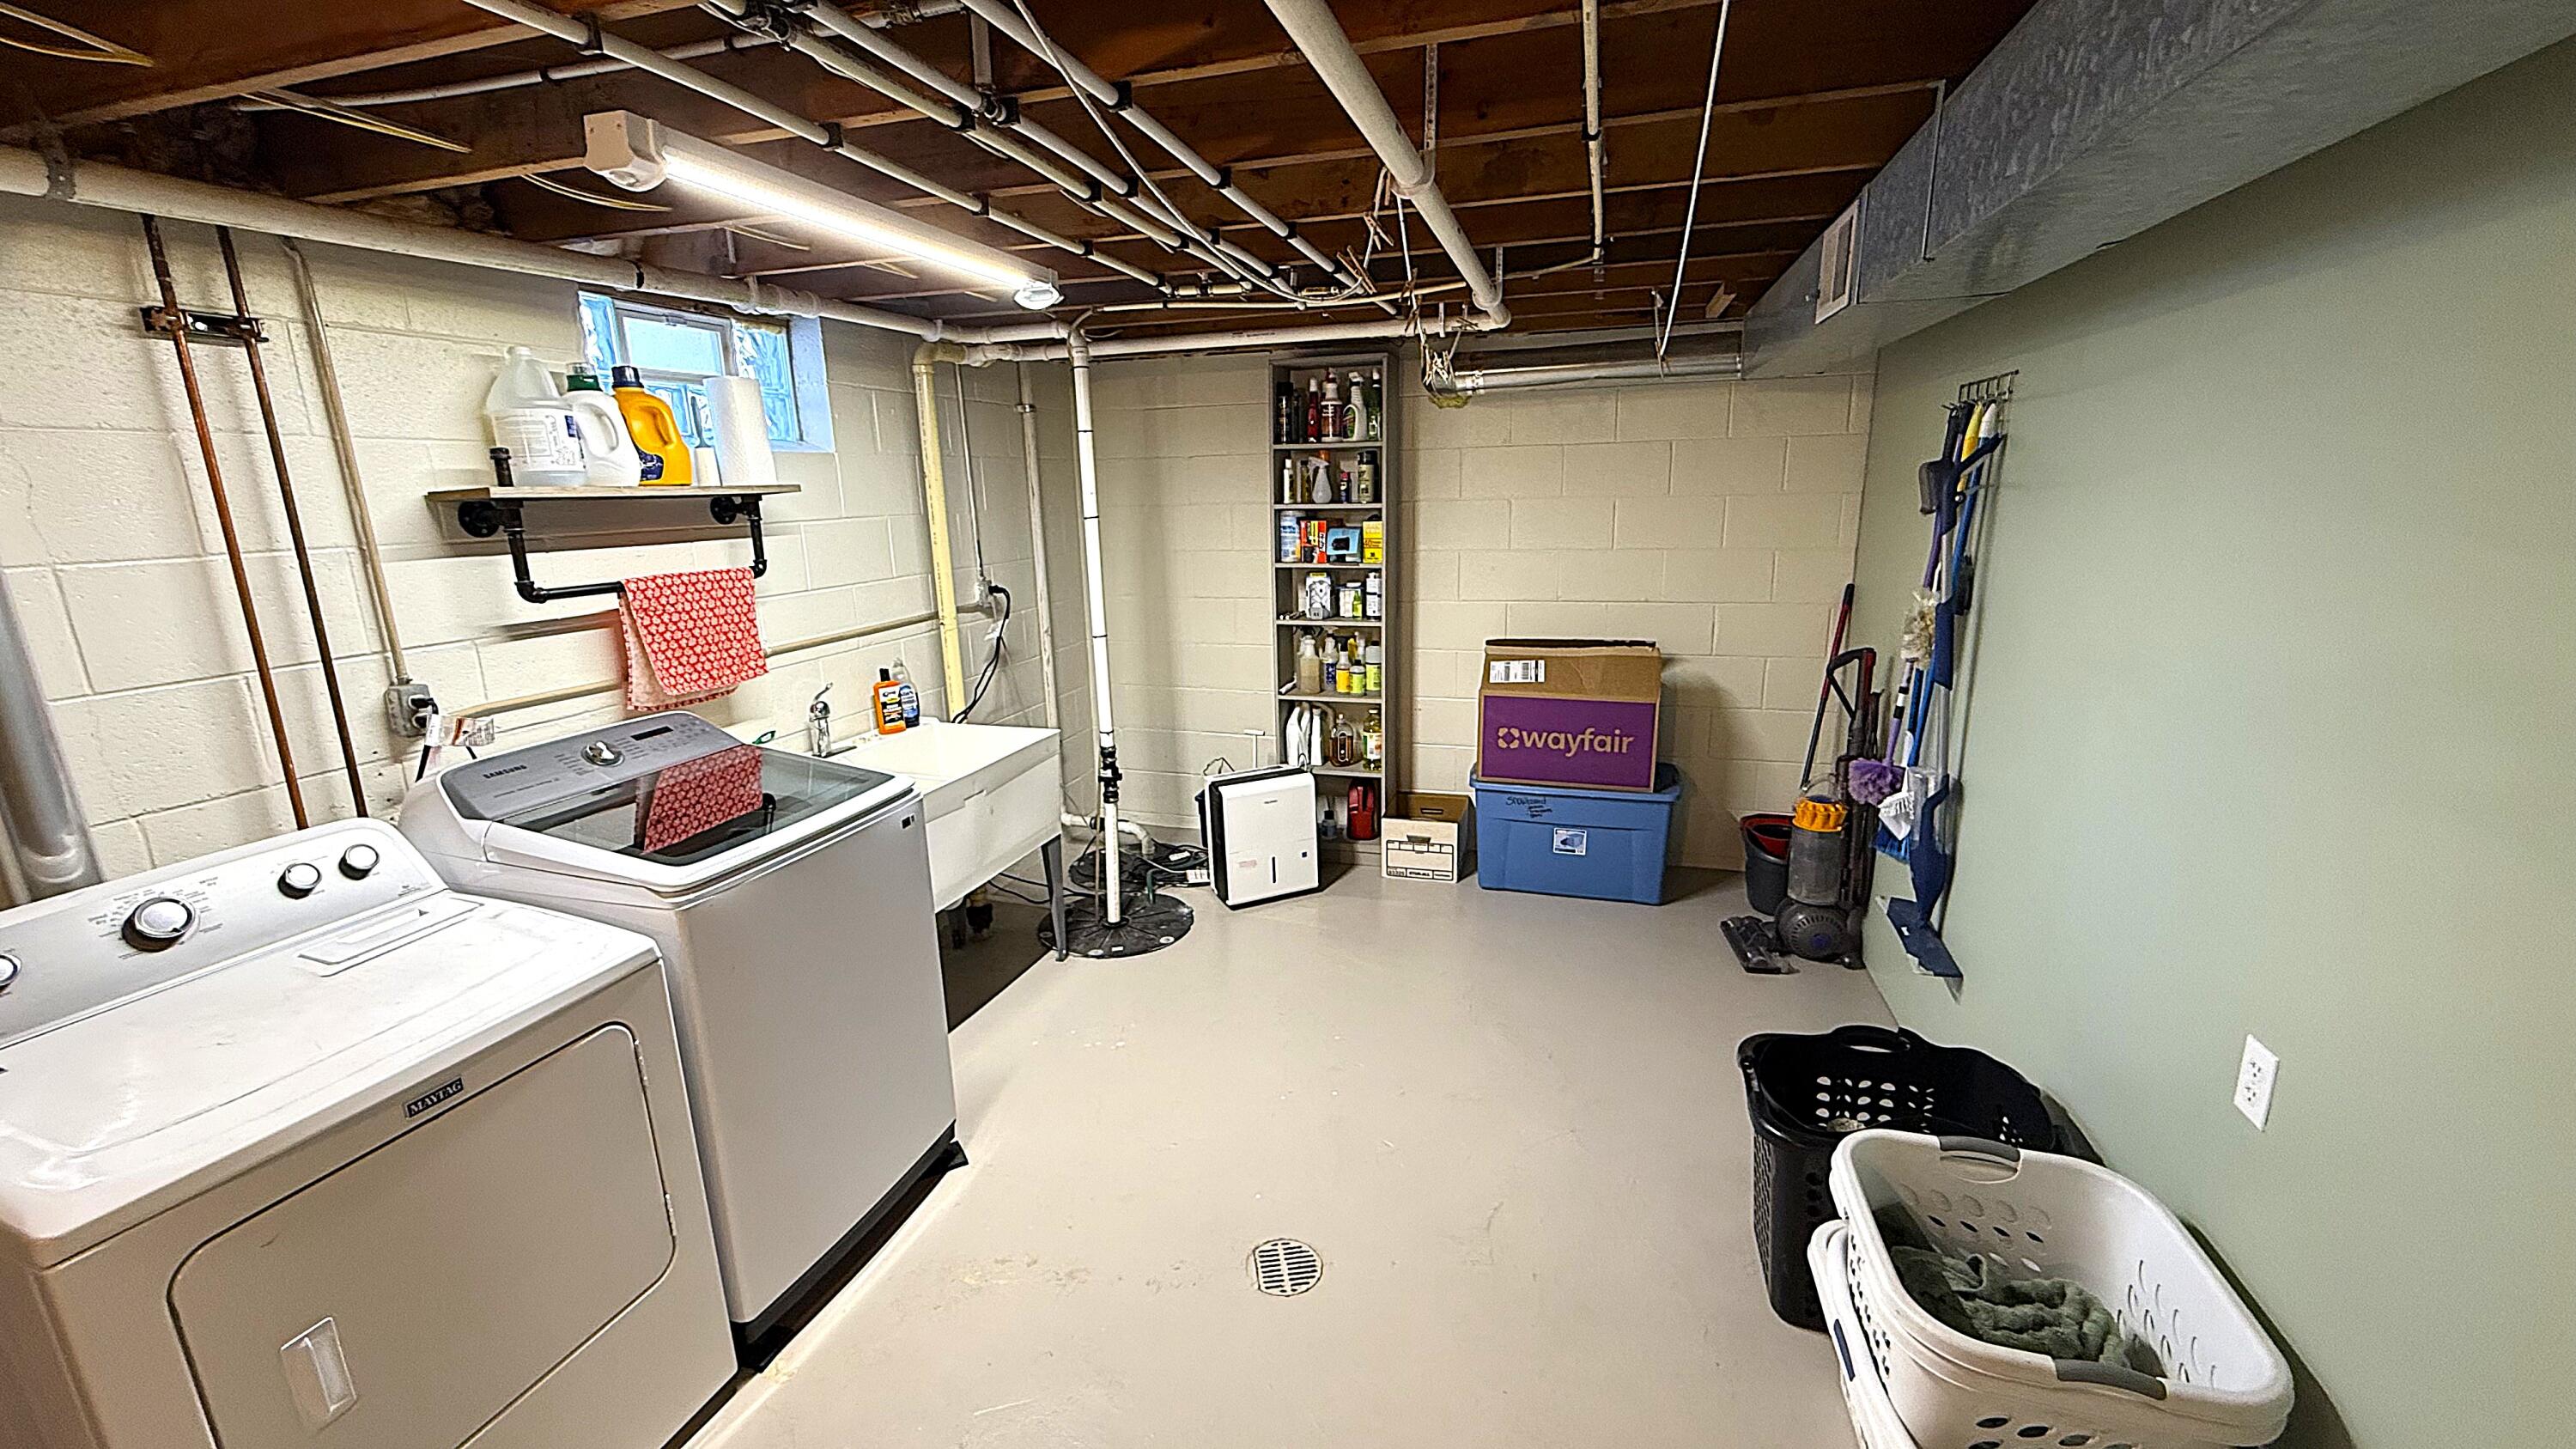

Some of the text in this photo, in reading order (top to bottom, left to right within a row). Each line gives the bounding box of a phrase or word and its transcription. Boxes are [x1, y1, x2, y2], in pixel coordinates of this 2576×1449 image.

[1522, 728, 1634, 757] wayfair
[483, 764, 527, 779] SAMSUNG
[410, 1081, 462, 1115] MAYTAG
